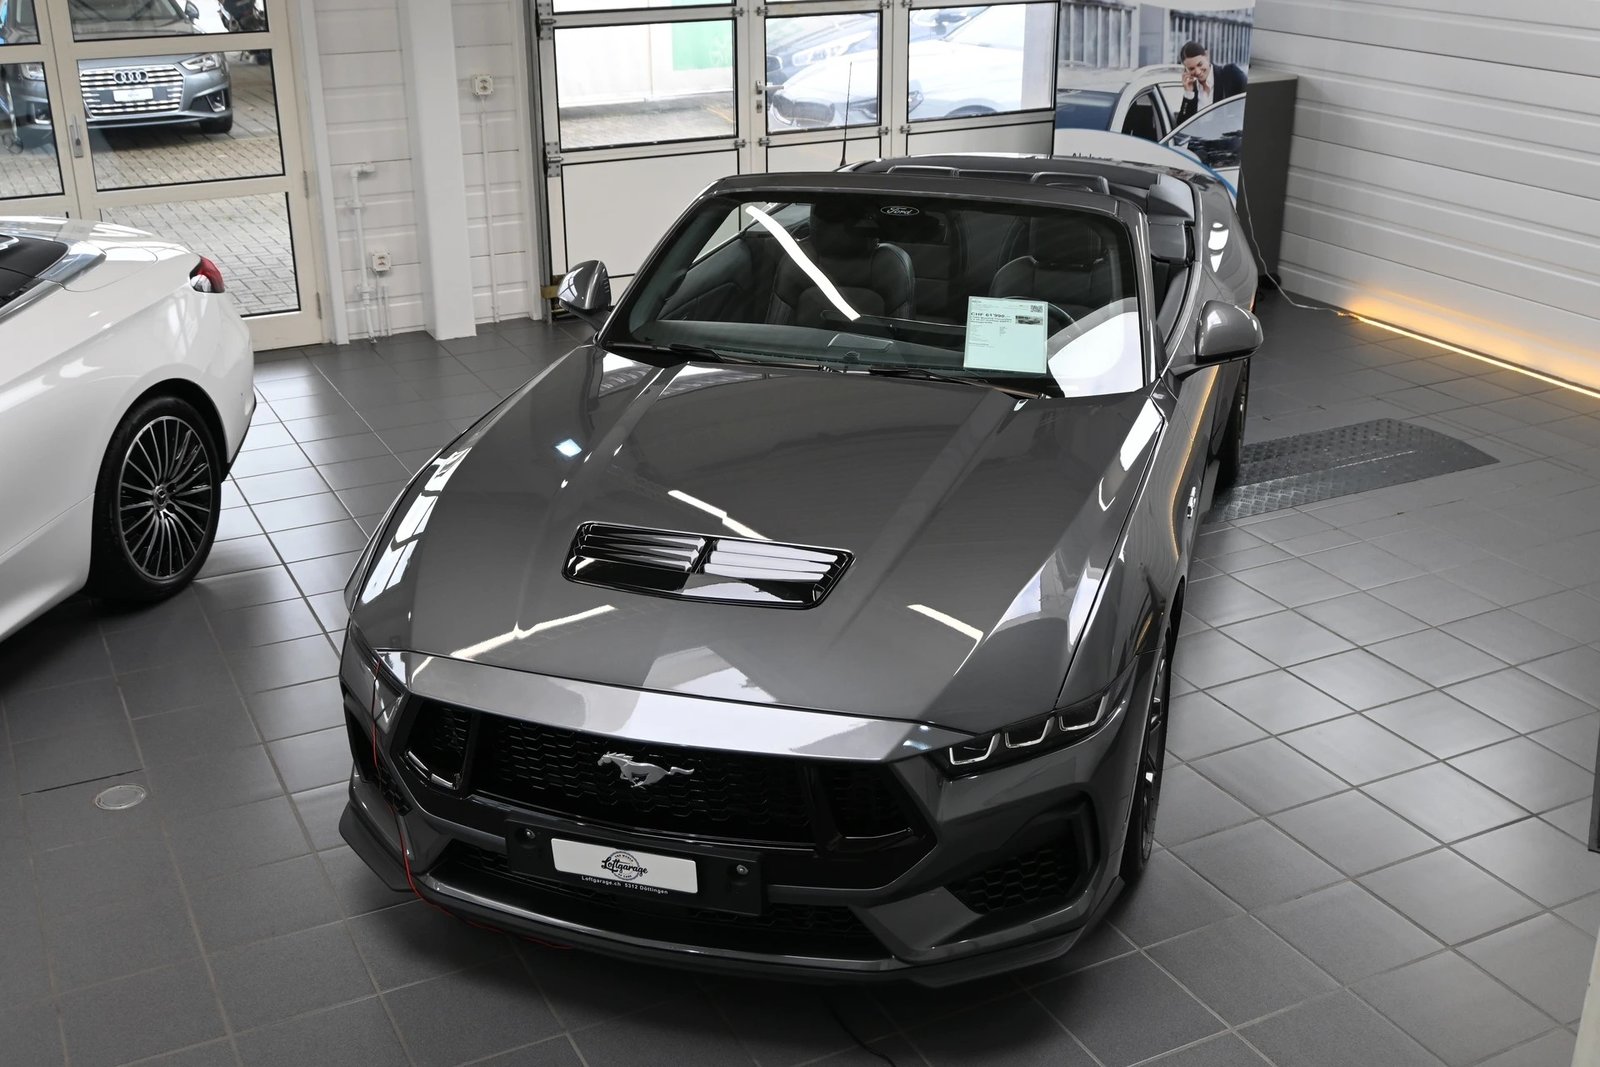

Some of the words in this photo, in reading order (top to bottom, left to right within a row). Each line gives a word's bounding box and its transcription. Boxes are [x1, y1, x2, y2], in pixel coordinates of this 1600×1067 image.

[886, 207, 913, 215] Ford
[601, 856, 648, 877] Loftgarage
[581, 876, 621, 886] Loftgarage.ch
[639, 885, 669, 895] Döttingen
